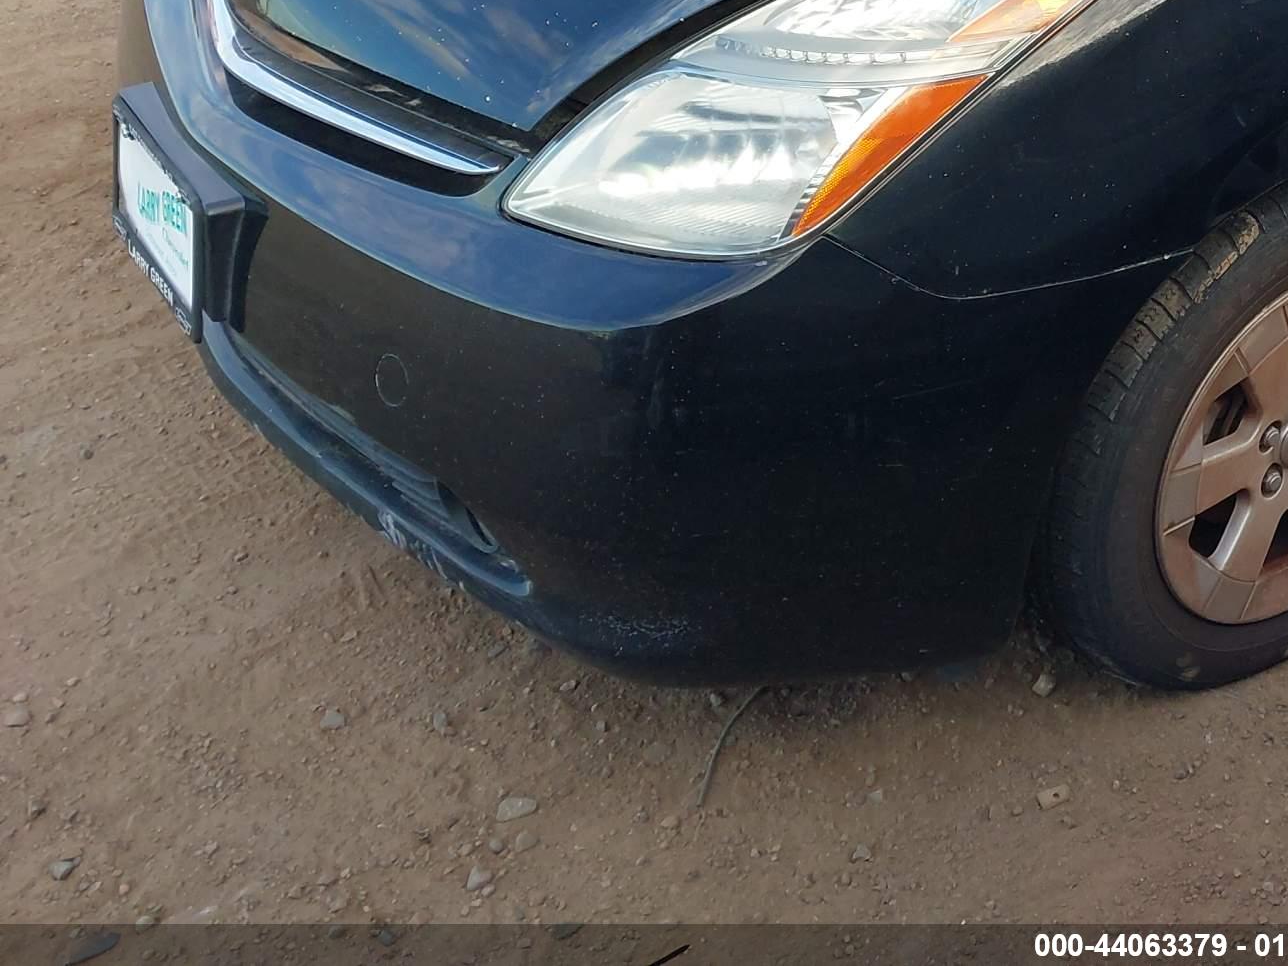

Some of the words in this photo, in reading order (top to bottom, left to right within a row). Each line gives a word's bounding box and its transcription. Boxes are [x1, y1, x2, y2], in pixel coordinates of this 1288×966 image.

[137, 182, 160, 224] LARRY
[162, 190, 188, 236] GREEN
[128, 239, 150, 277] LARRY
[150, 266, 174, 306] GREEN
